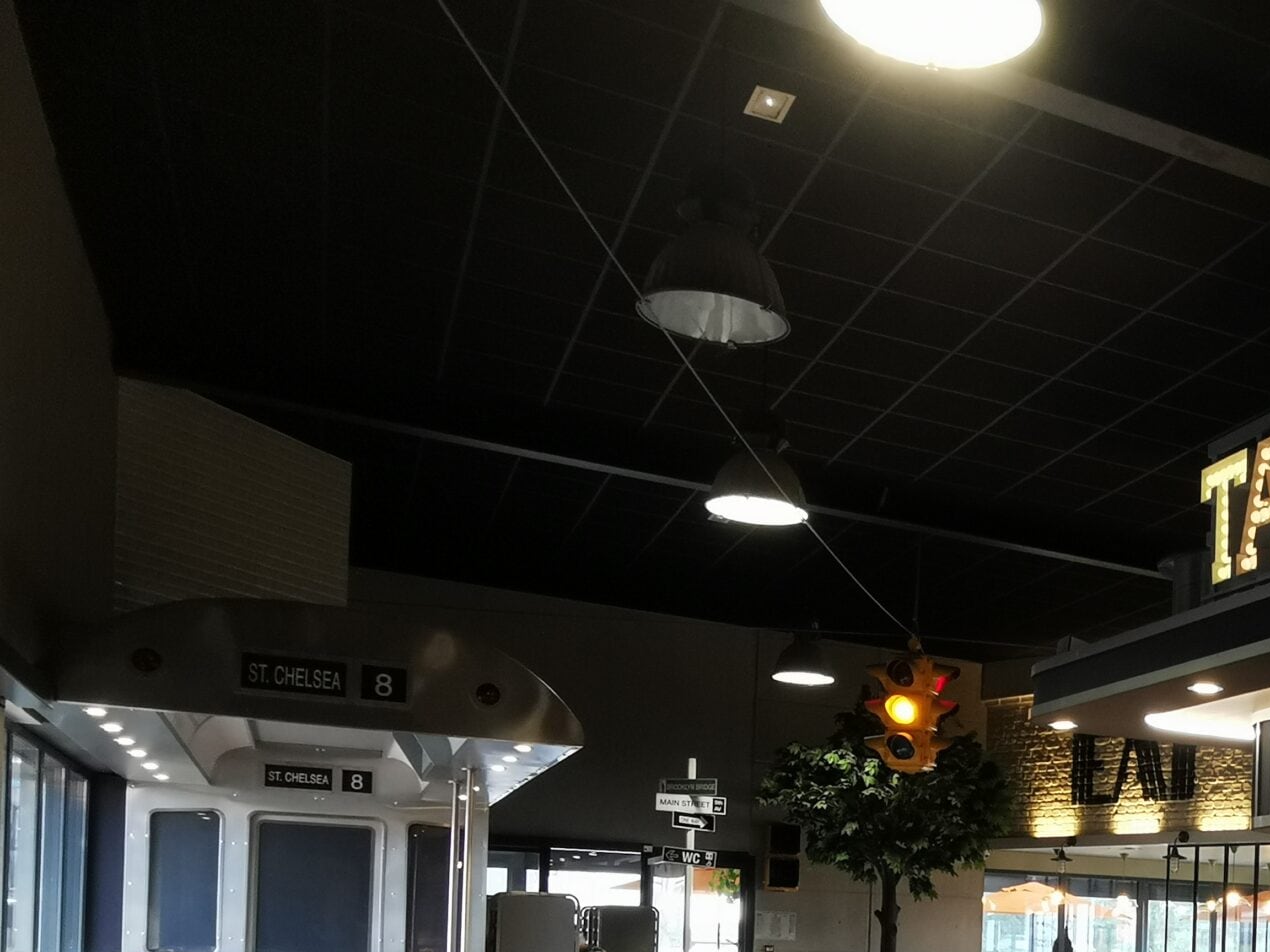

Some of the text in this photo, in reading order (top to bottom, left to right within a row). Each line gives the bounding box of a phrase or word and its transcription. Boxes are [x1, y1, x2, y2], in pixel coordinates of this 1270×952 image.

[249, 663, 342, 691] ST. CHELSEA
[374, 673, 393, 697] 8
[268, 771, 329, 785] ST. CHELSEA
[351, 774, 363, 790] 8
[659, 798, 710, 808] MAIN STREET
[682, 851, 700, 864] WC
